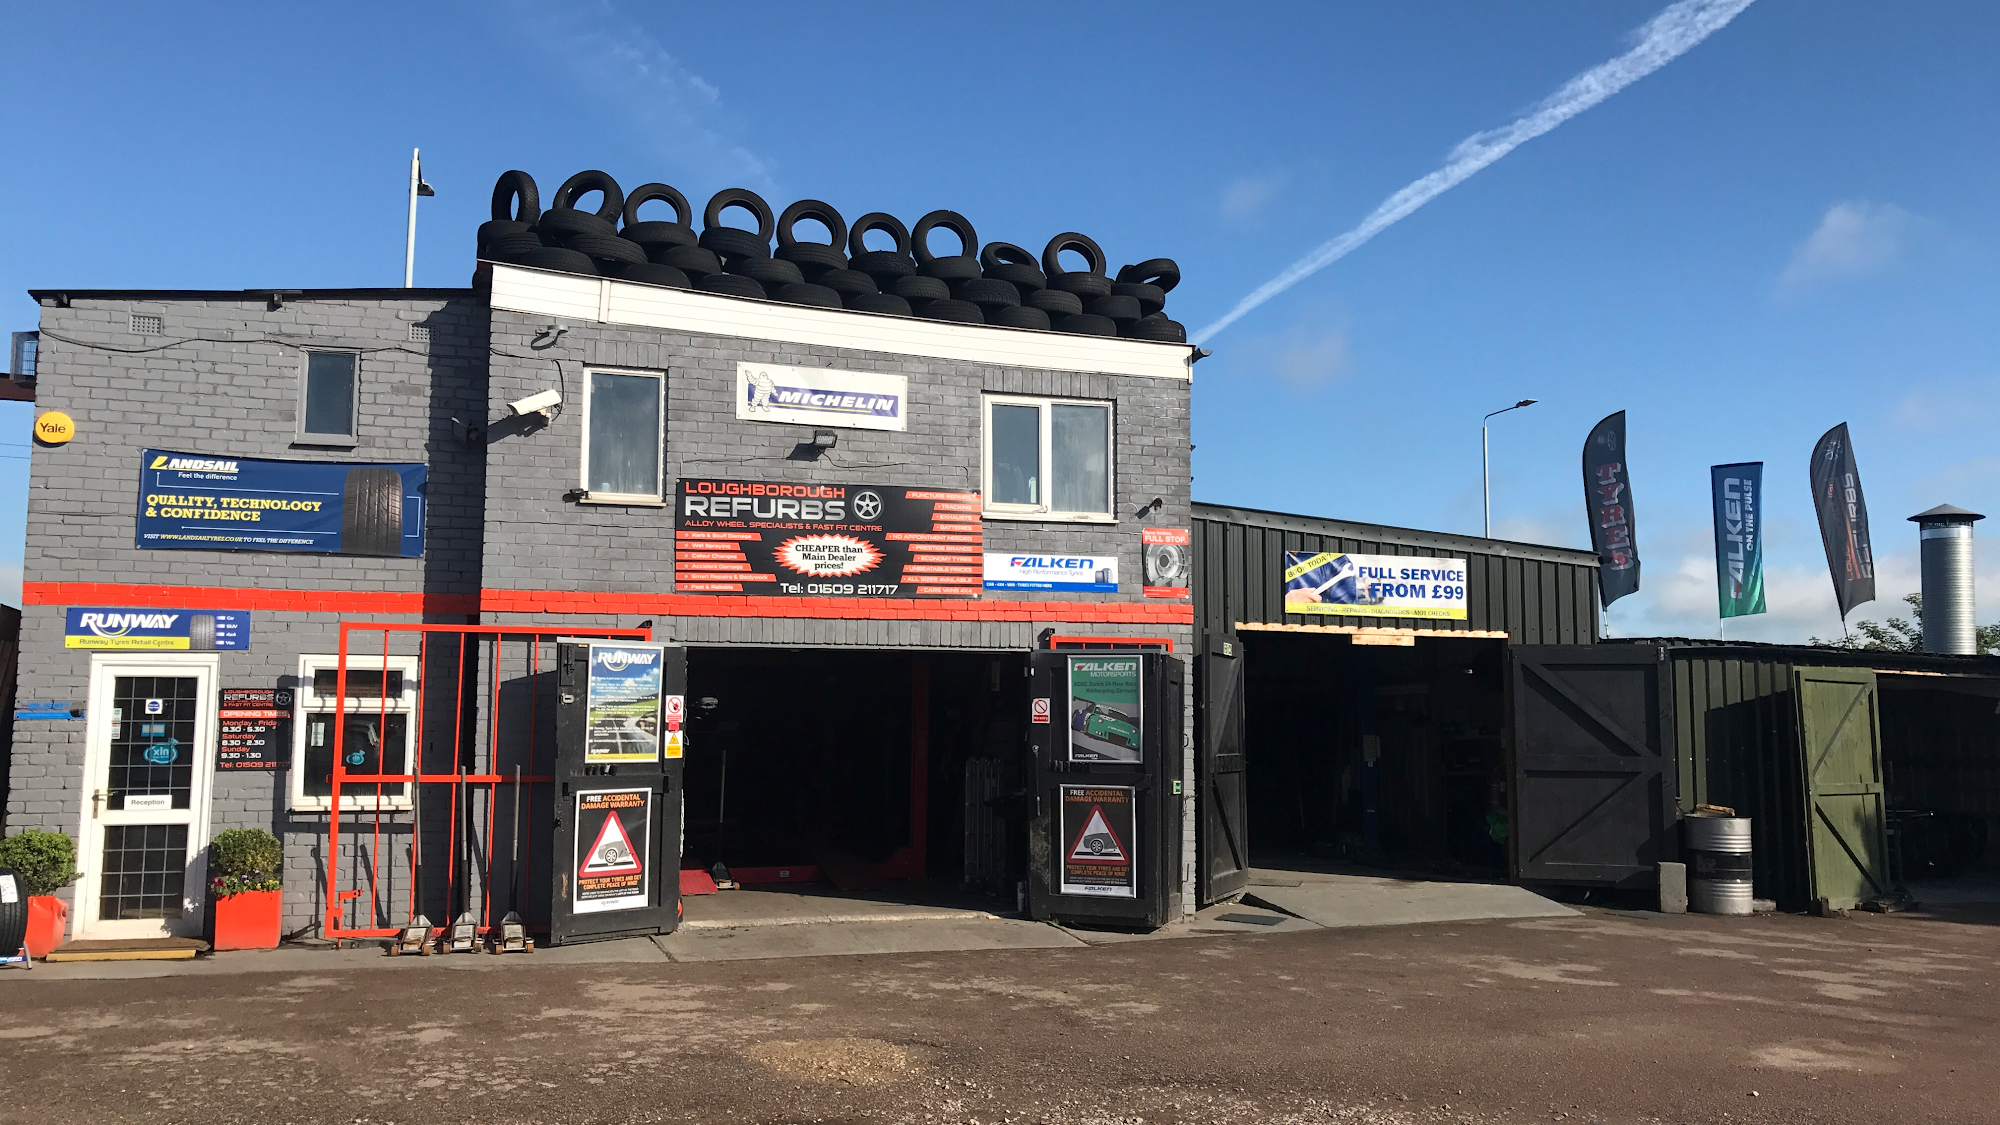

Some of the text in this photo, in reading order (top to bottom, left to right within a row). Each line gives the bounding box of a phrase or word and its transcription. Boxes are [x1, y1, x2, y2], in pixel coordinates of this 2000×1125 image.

[778, 391, 894, 411] MICHELIN
[40, 422, 66, 433] Yale
[150, 456, 239, 472] LANDSAIL
[685, 481, 845, 499] LOUGHBOROUGH
[146, 494, 322, 512] QUALITY, TECHNOLOGY
[685, 496, 846, 520] REFURBS
[145, 507, 261, 522] & CONFIDENCE
[1596, 462, 1634, 571] TYRES
[1744, 479, 1754, 551] ON THE PULSE
[849, 524, 882, 532] CENTRE
[1724, 477, 1744, 599] FALKEN
[795, 544, 863, 553] CHEAPER than
[802, 553, 856, 562] Main Dealer
[1010, 557, 1094, 569] FALKEN
[814, 562, 844, 570] prices!
[1359, 566, 1464, 582] FULL SERVICE
[780, 582, 899, 595] Tel: 01509 211717
[1370, 582, 1464, 600] FROM £99
[1306, 605, 1338, 613] SERVICING
[80, 613, 179, 631] RUNWAY
[79, 638, 108, 646] Runway
[598, 652, 656, 667] RUNWAY
[1074, 662, 1137, 671] FALKEN
[581, 800, 645, 810] DAMAGE WARRANTY
[586, 793, 641, 803] FREE ACCIDENTAL
